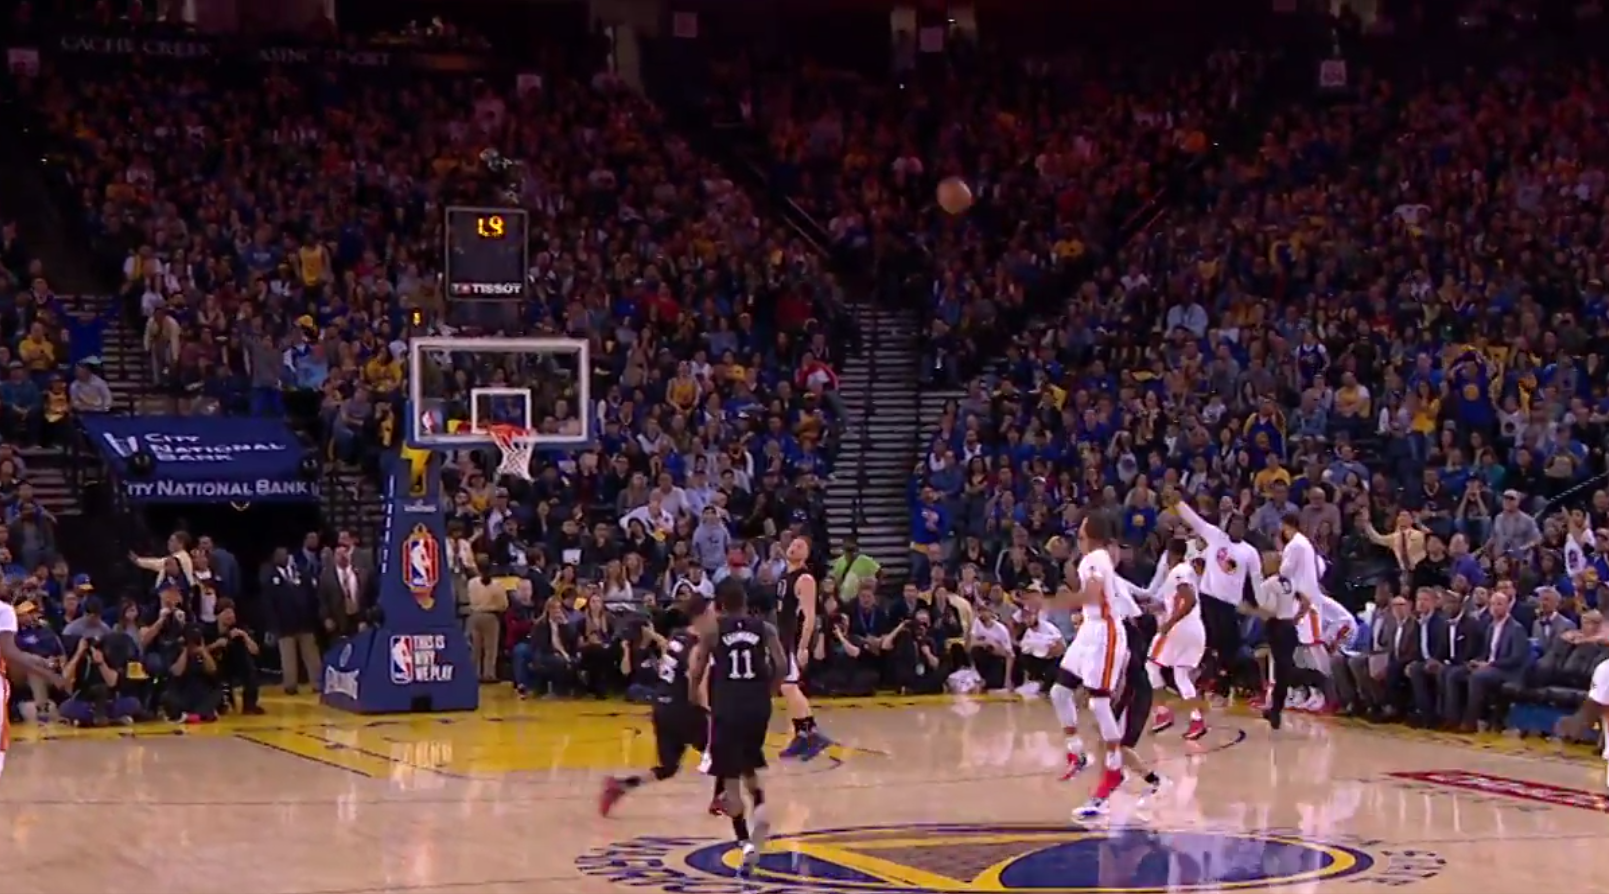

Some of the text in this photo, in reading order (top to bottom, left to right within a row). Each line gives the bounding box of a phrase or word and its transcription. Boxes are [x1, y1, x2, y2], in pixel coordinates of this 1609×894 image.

[471, 281, 521, 294] TISSOT
[144, 433, 199, 442] CITY
[150, 443, 287, 454] NATIONAL
[156, 452, 235, 462] BANK
[123, 478, 307, 497] ITY NATIONAL BANK
[728, 648, 756, 680] 11
